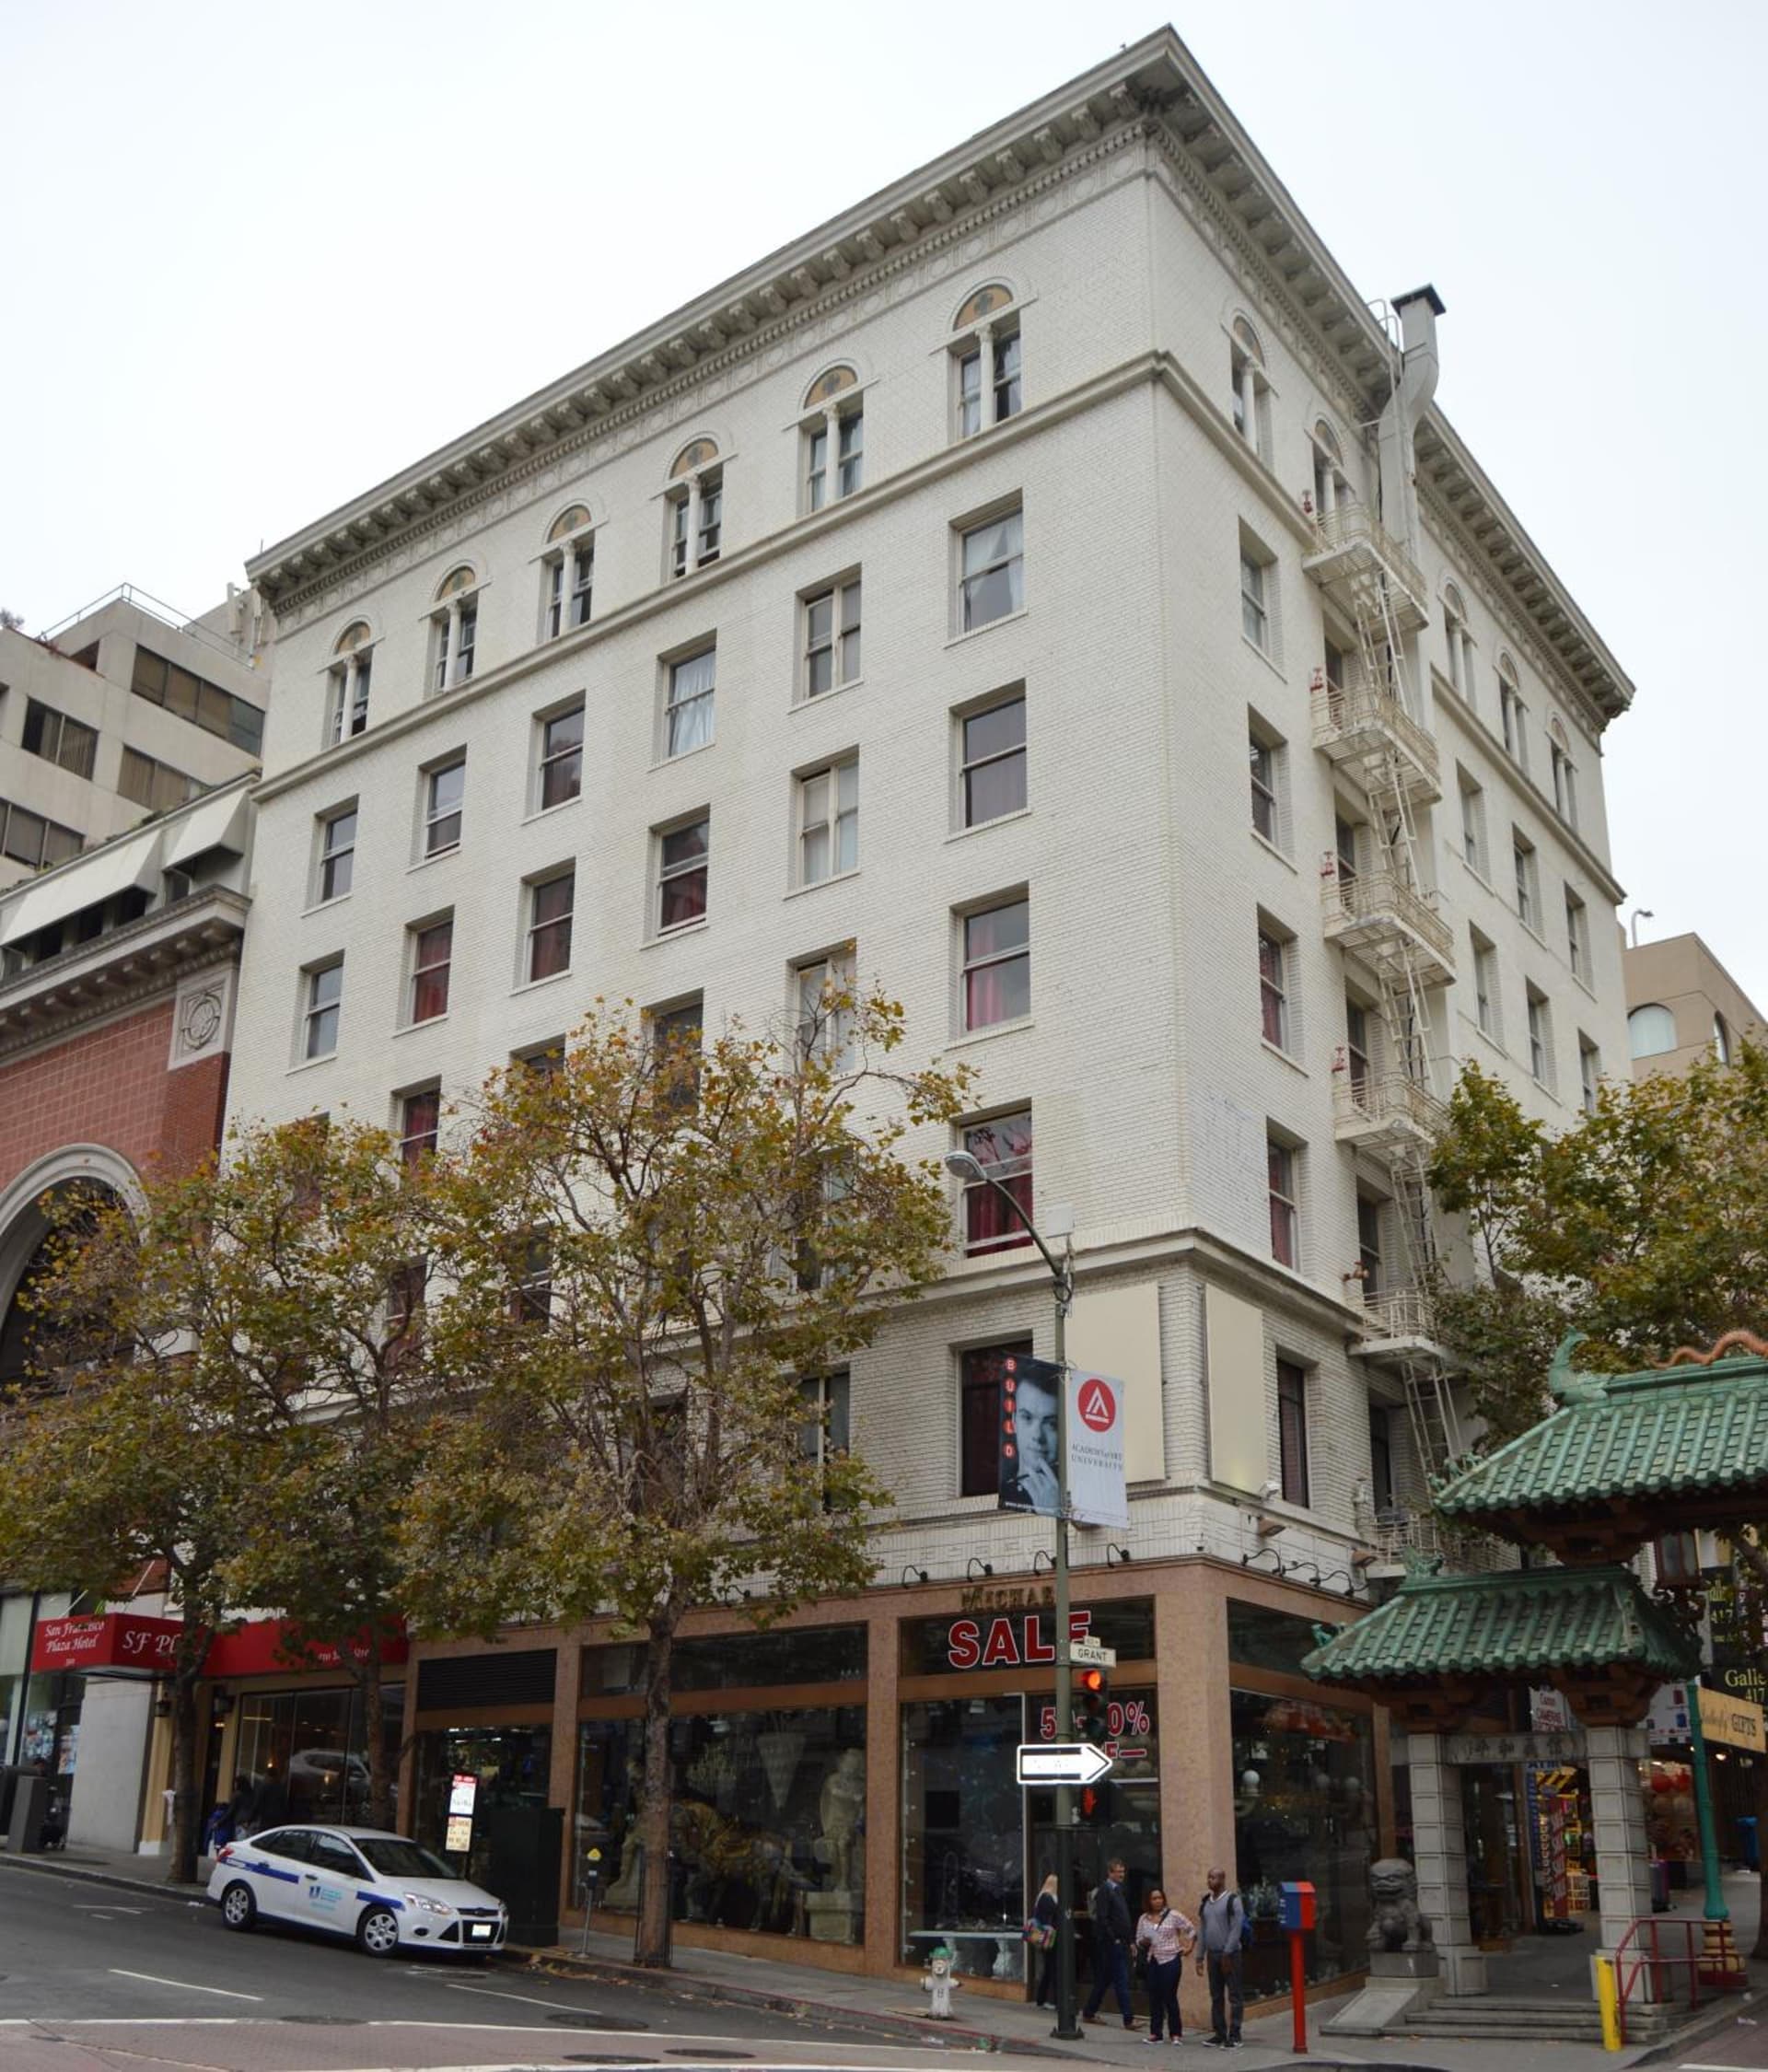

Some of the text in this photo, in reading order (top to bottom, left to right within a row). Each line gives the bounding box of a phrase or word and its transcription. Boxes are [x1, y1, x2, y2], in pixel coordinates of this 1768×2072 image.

[1003, 1356, 1017, 1458] BUILD
[1071, 1453, 1122, 1471] UNIVERSITY
[960, 1586, 1056, 1612] MICHAE
[45, 1621, 105, 1637] San Frisco
[46, 1634, 99, 1654] Plaza Hotel
[122, 1631, 151, 1654] SF
[948, 1611, 1091, 1669] SALE
[1077, 1648, 1107, 1662] GRANT
[1725, 1668, 1767, 1687] Galle
[1746, 1687, 1765, 1703] 417
[1040, 1702, 1150, 1740] 5-0%
